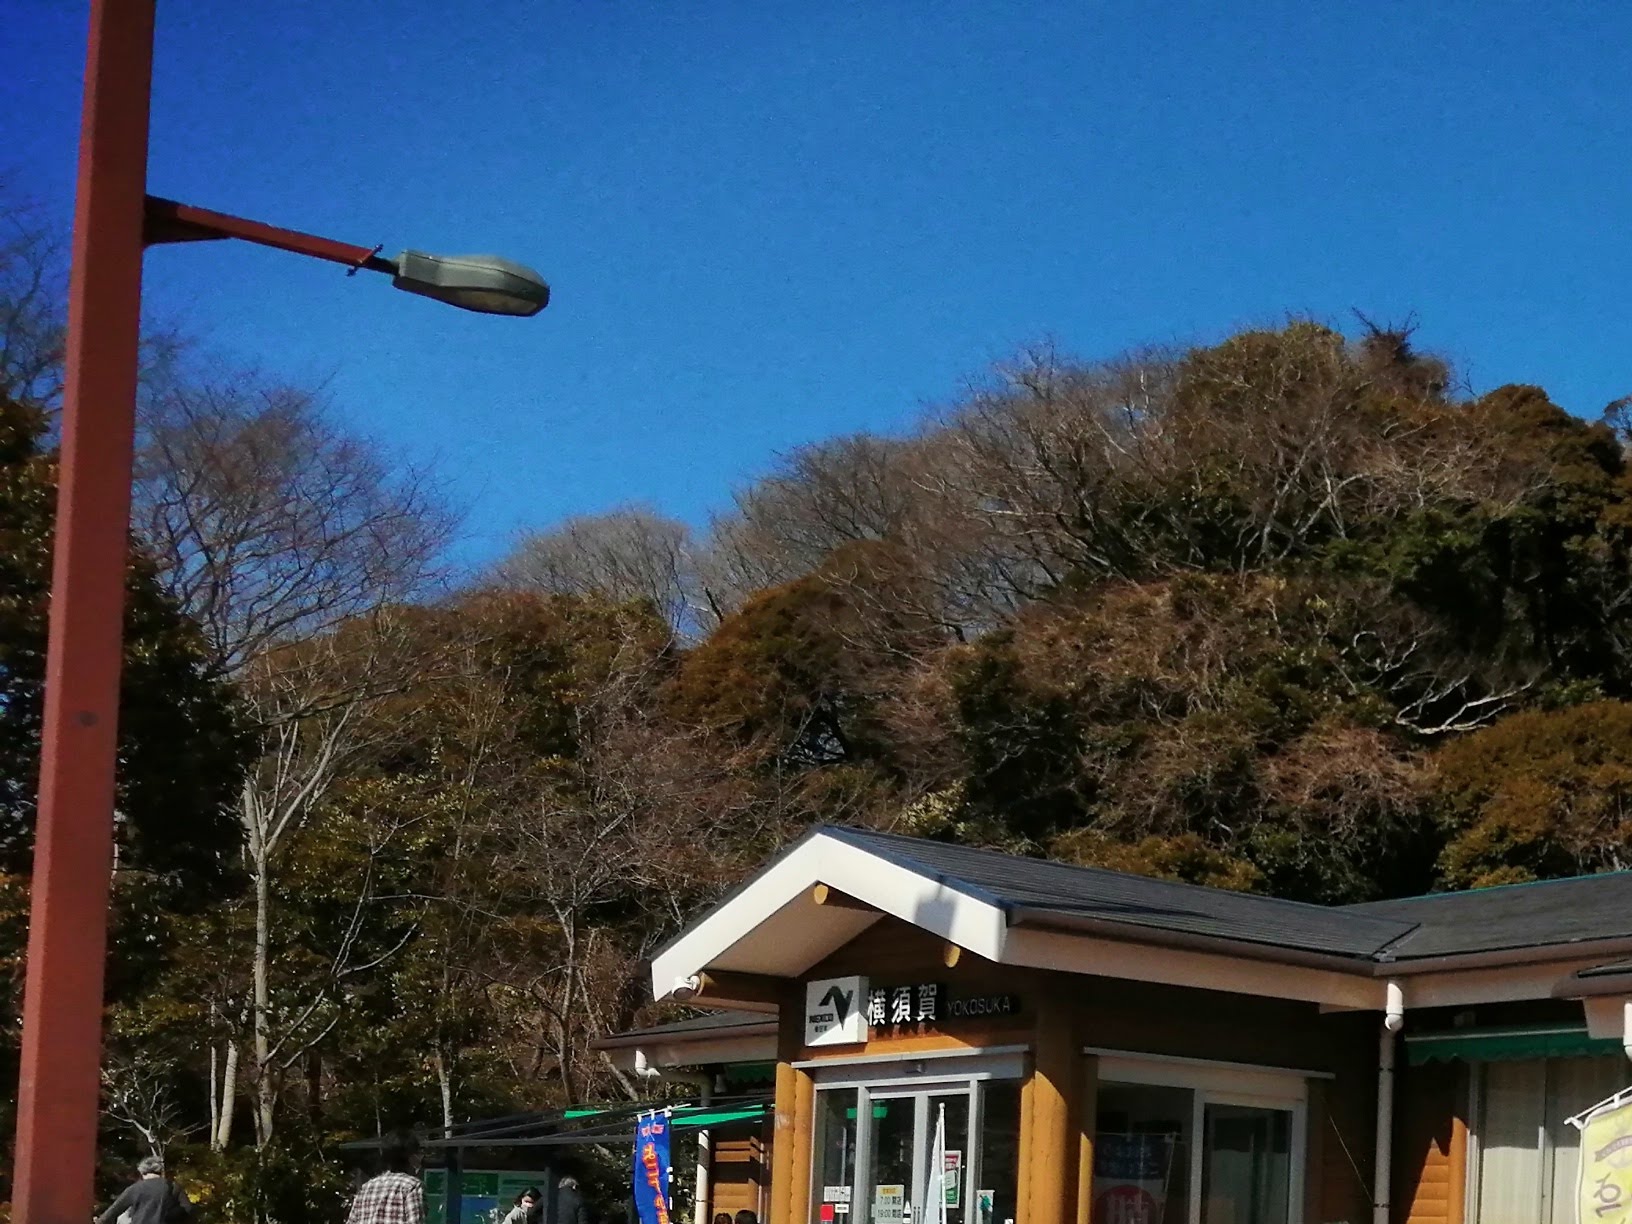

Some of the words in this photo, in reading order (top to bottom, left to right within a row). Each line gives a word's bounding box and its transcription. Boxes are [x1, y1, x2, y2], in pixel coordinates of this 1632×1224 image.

[867, 983, 937, 1026] 横須賀
[948, 996, 1011, 1017] YOKOSUKA
